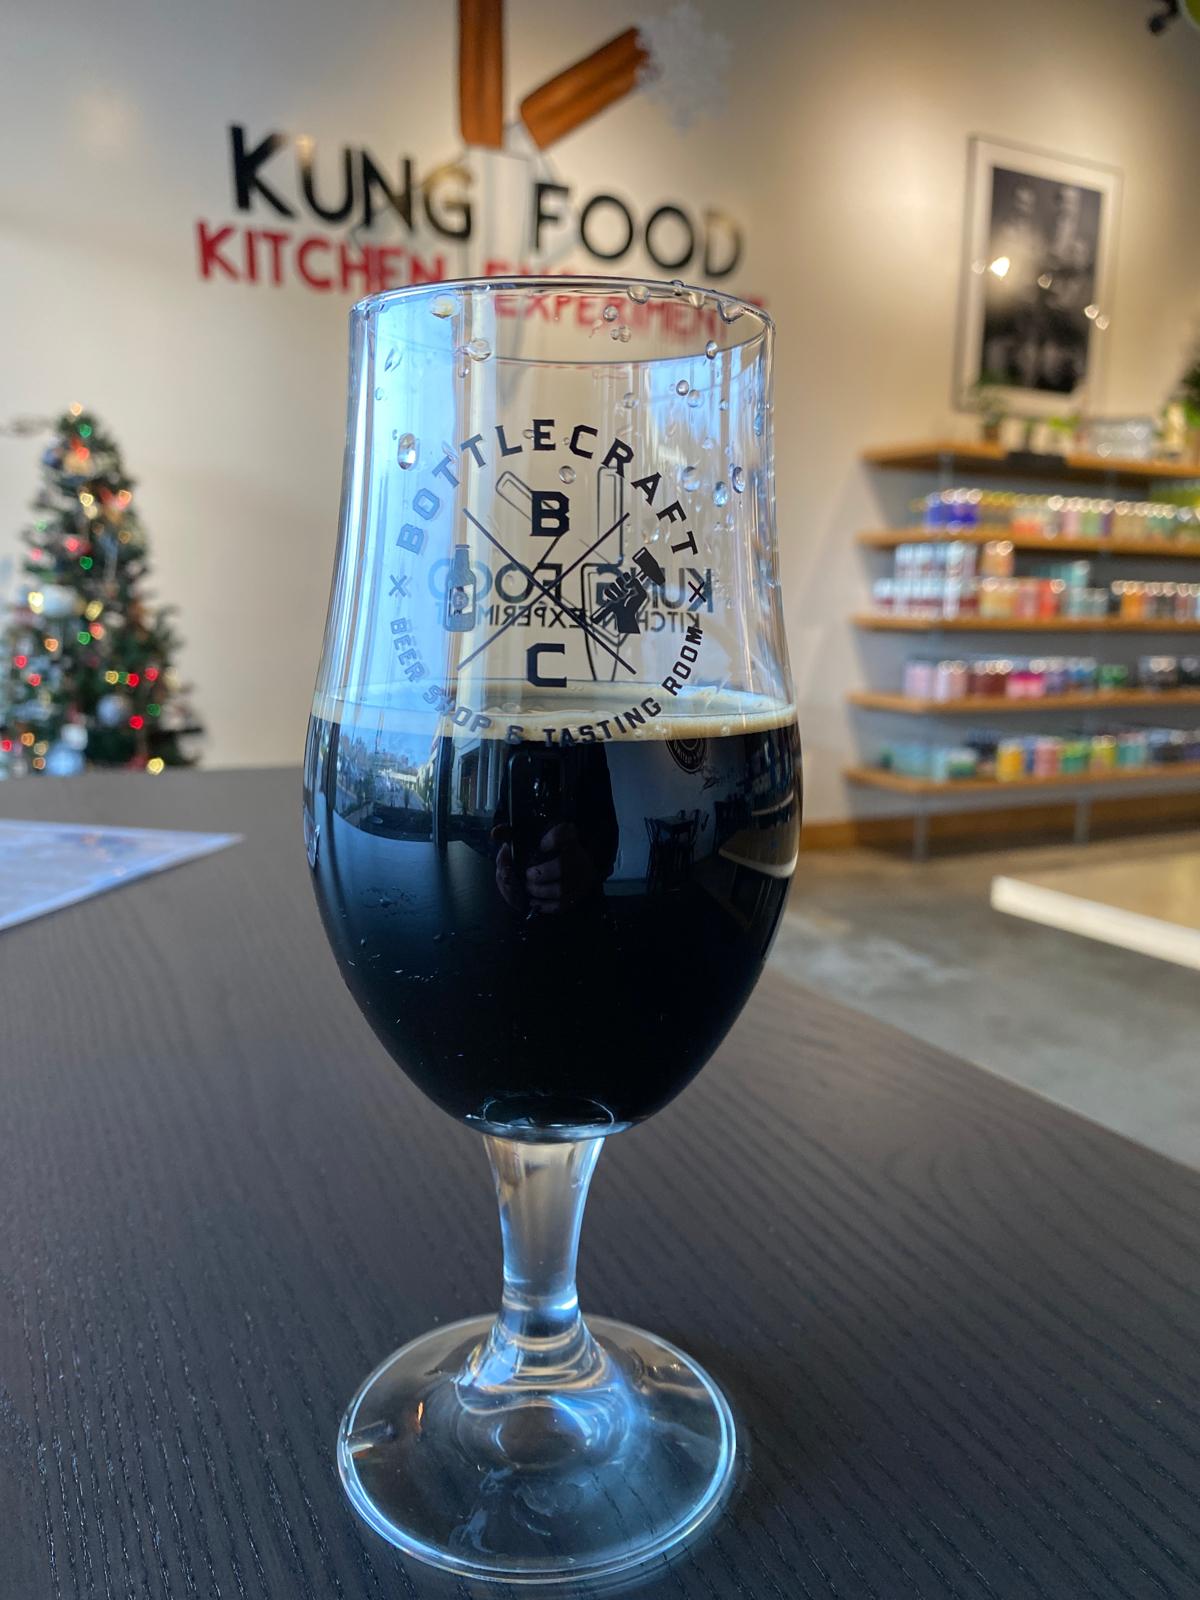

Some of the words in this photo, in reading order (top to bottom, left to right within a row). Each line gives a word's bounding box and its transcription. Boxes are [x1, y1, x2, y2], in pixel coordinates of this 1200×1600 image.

[229, 122, 474, 242] KUNG
[532, 181, 747, 280] FOOD
[194, 218, 446, 294] KITCHEN
[484, 259, 766, 342] EXPERIMEN
[395, 418, 698, 556] BOTTLECRAFT
[529, 490, 571, 537] B
[389, 617, 426, 683] BEER
[542, 696, 662, 748] TASTING
[661, 625, 704, 697] ROOM
[525, 642, 568, 688] C
